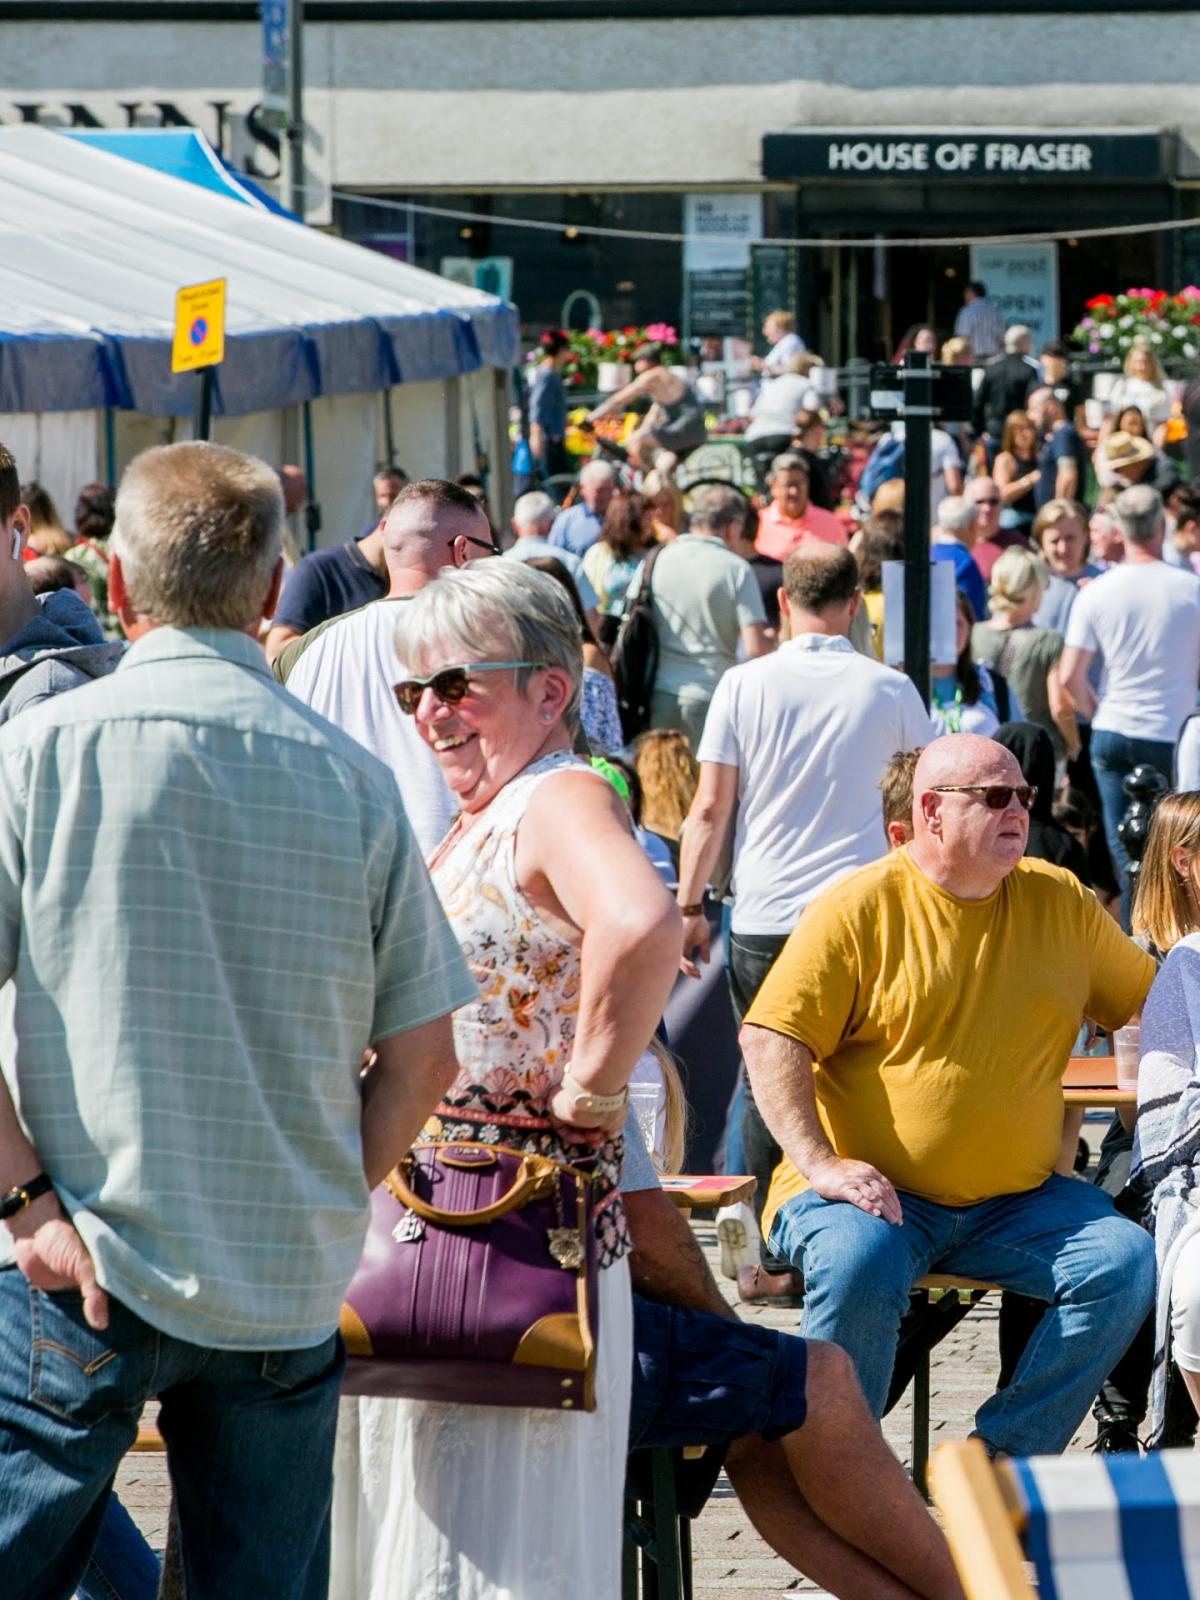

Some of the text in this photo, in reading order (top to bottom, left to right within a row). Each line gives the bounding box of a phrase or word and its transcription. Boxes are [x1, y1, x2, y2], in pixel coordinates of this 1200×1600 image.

[828, 142, 1092, 172] HOUSE OF FRASER
